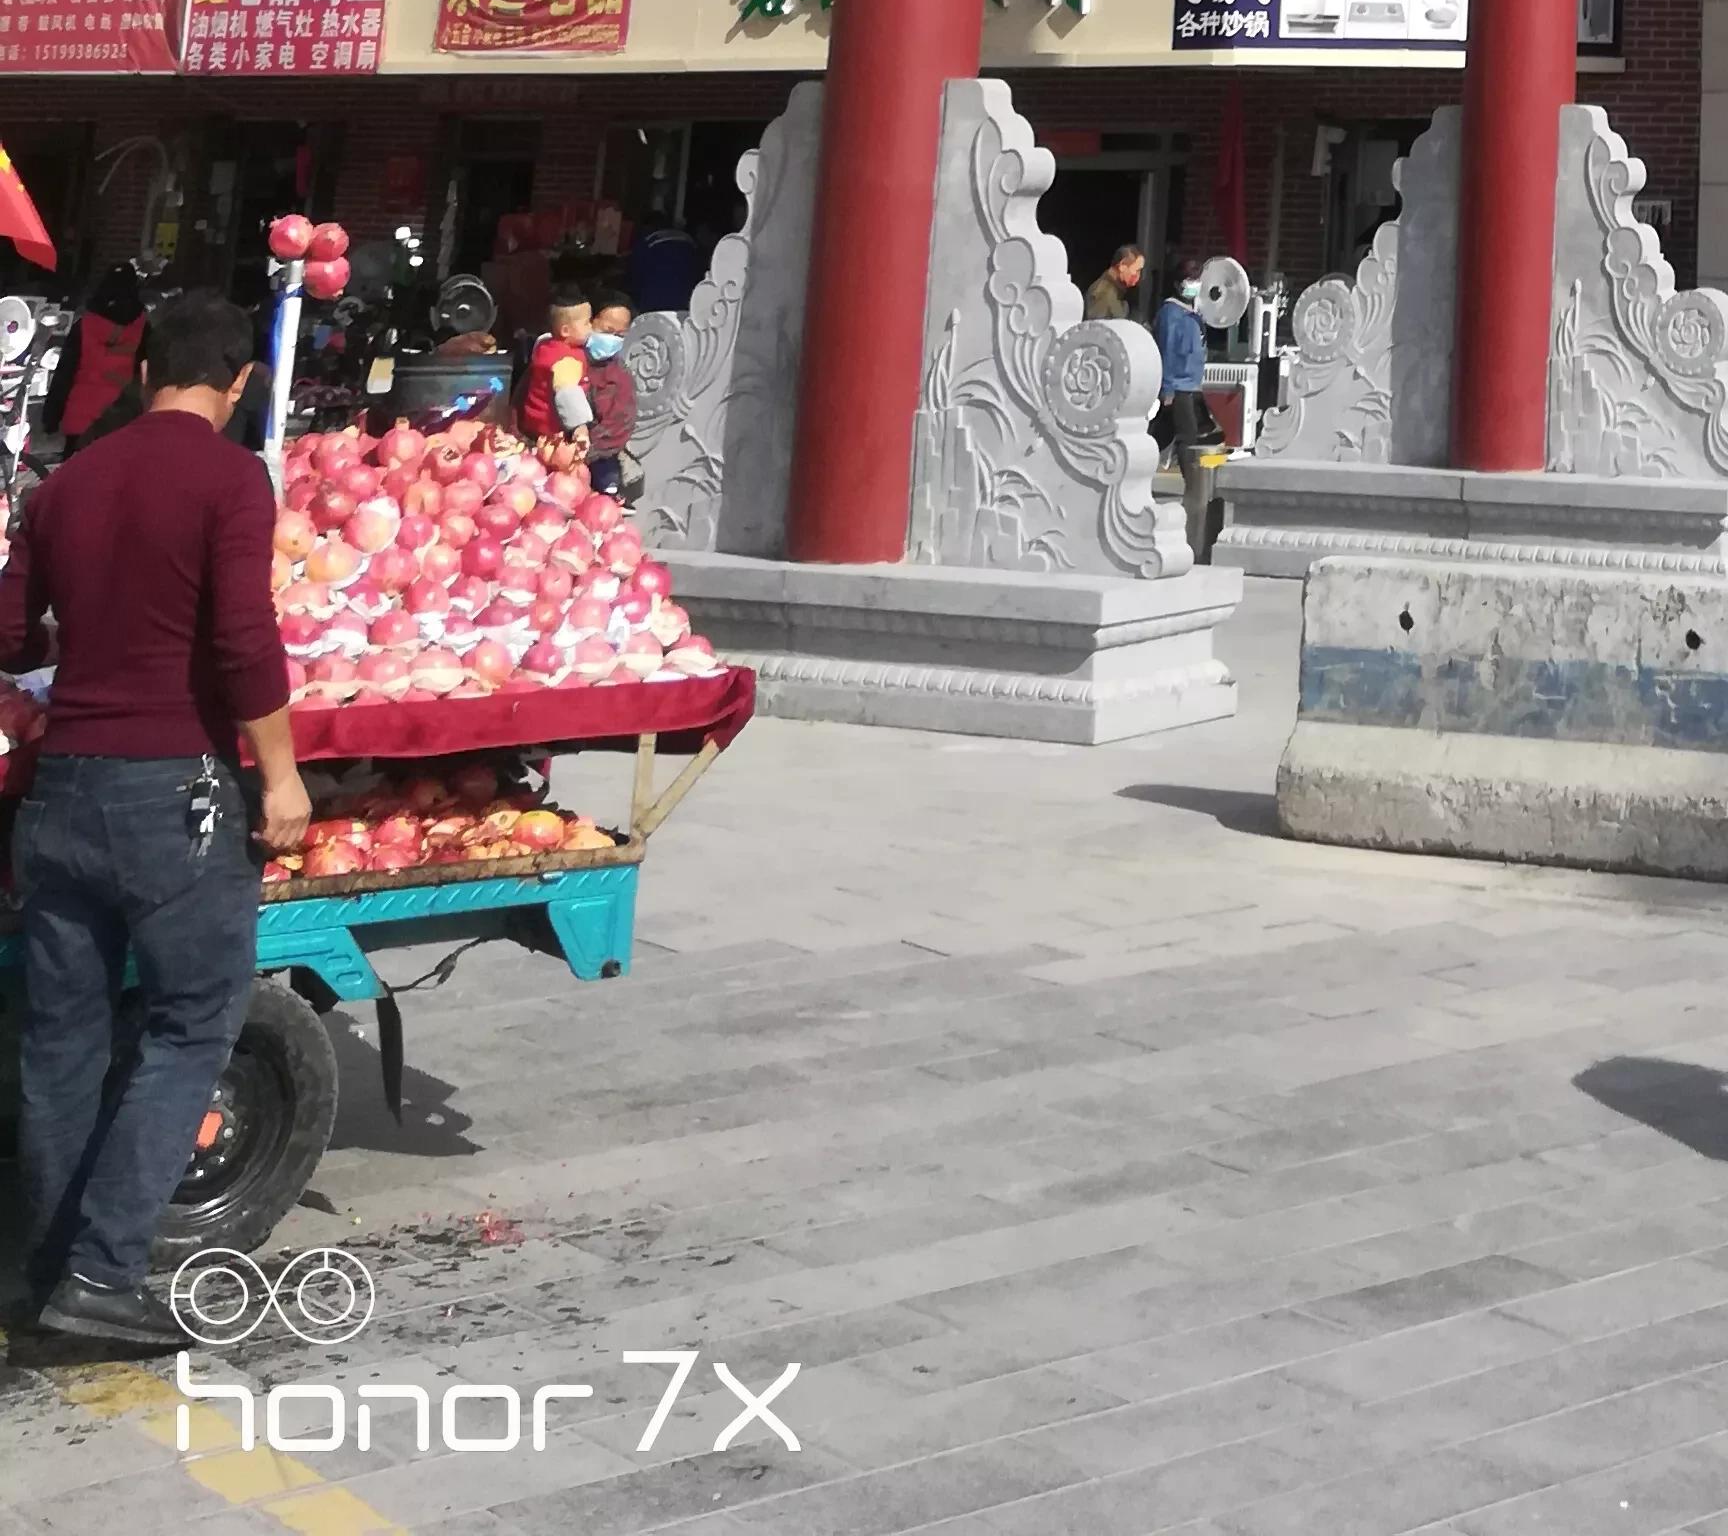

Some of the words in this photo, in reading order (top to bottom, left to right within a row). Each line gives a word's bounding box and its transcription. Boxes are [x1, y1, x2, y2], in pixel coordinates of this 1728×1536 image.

[191, 10, 248, 39] 油烟机
[253, 9, 314, 38] 燃气灶
[320, 8, 382, 37] 热水器
[1177, 11, 1270, 38] 各种炒锅
[187, 41, 296, 71] 各类小家电
[309, 40, 377, 69] 空调扇
